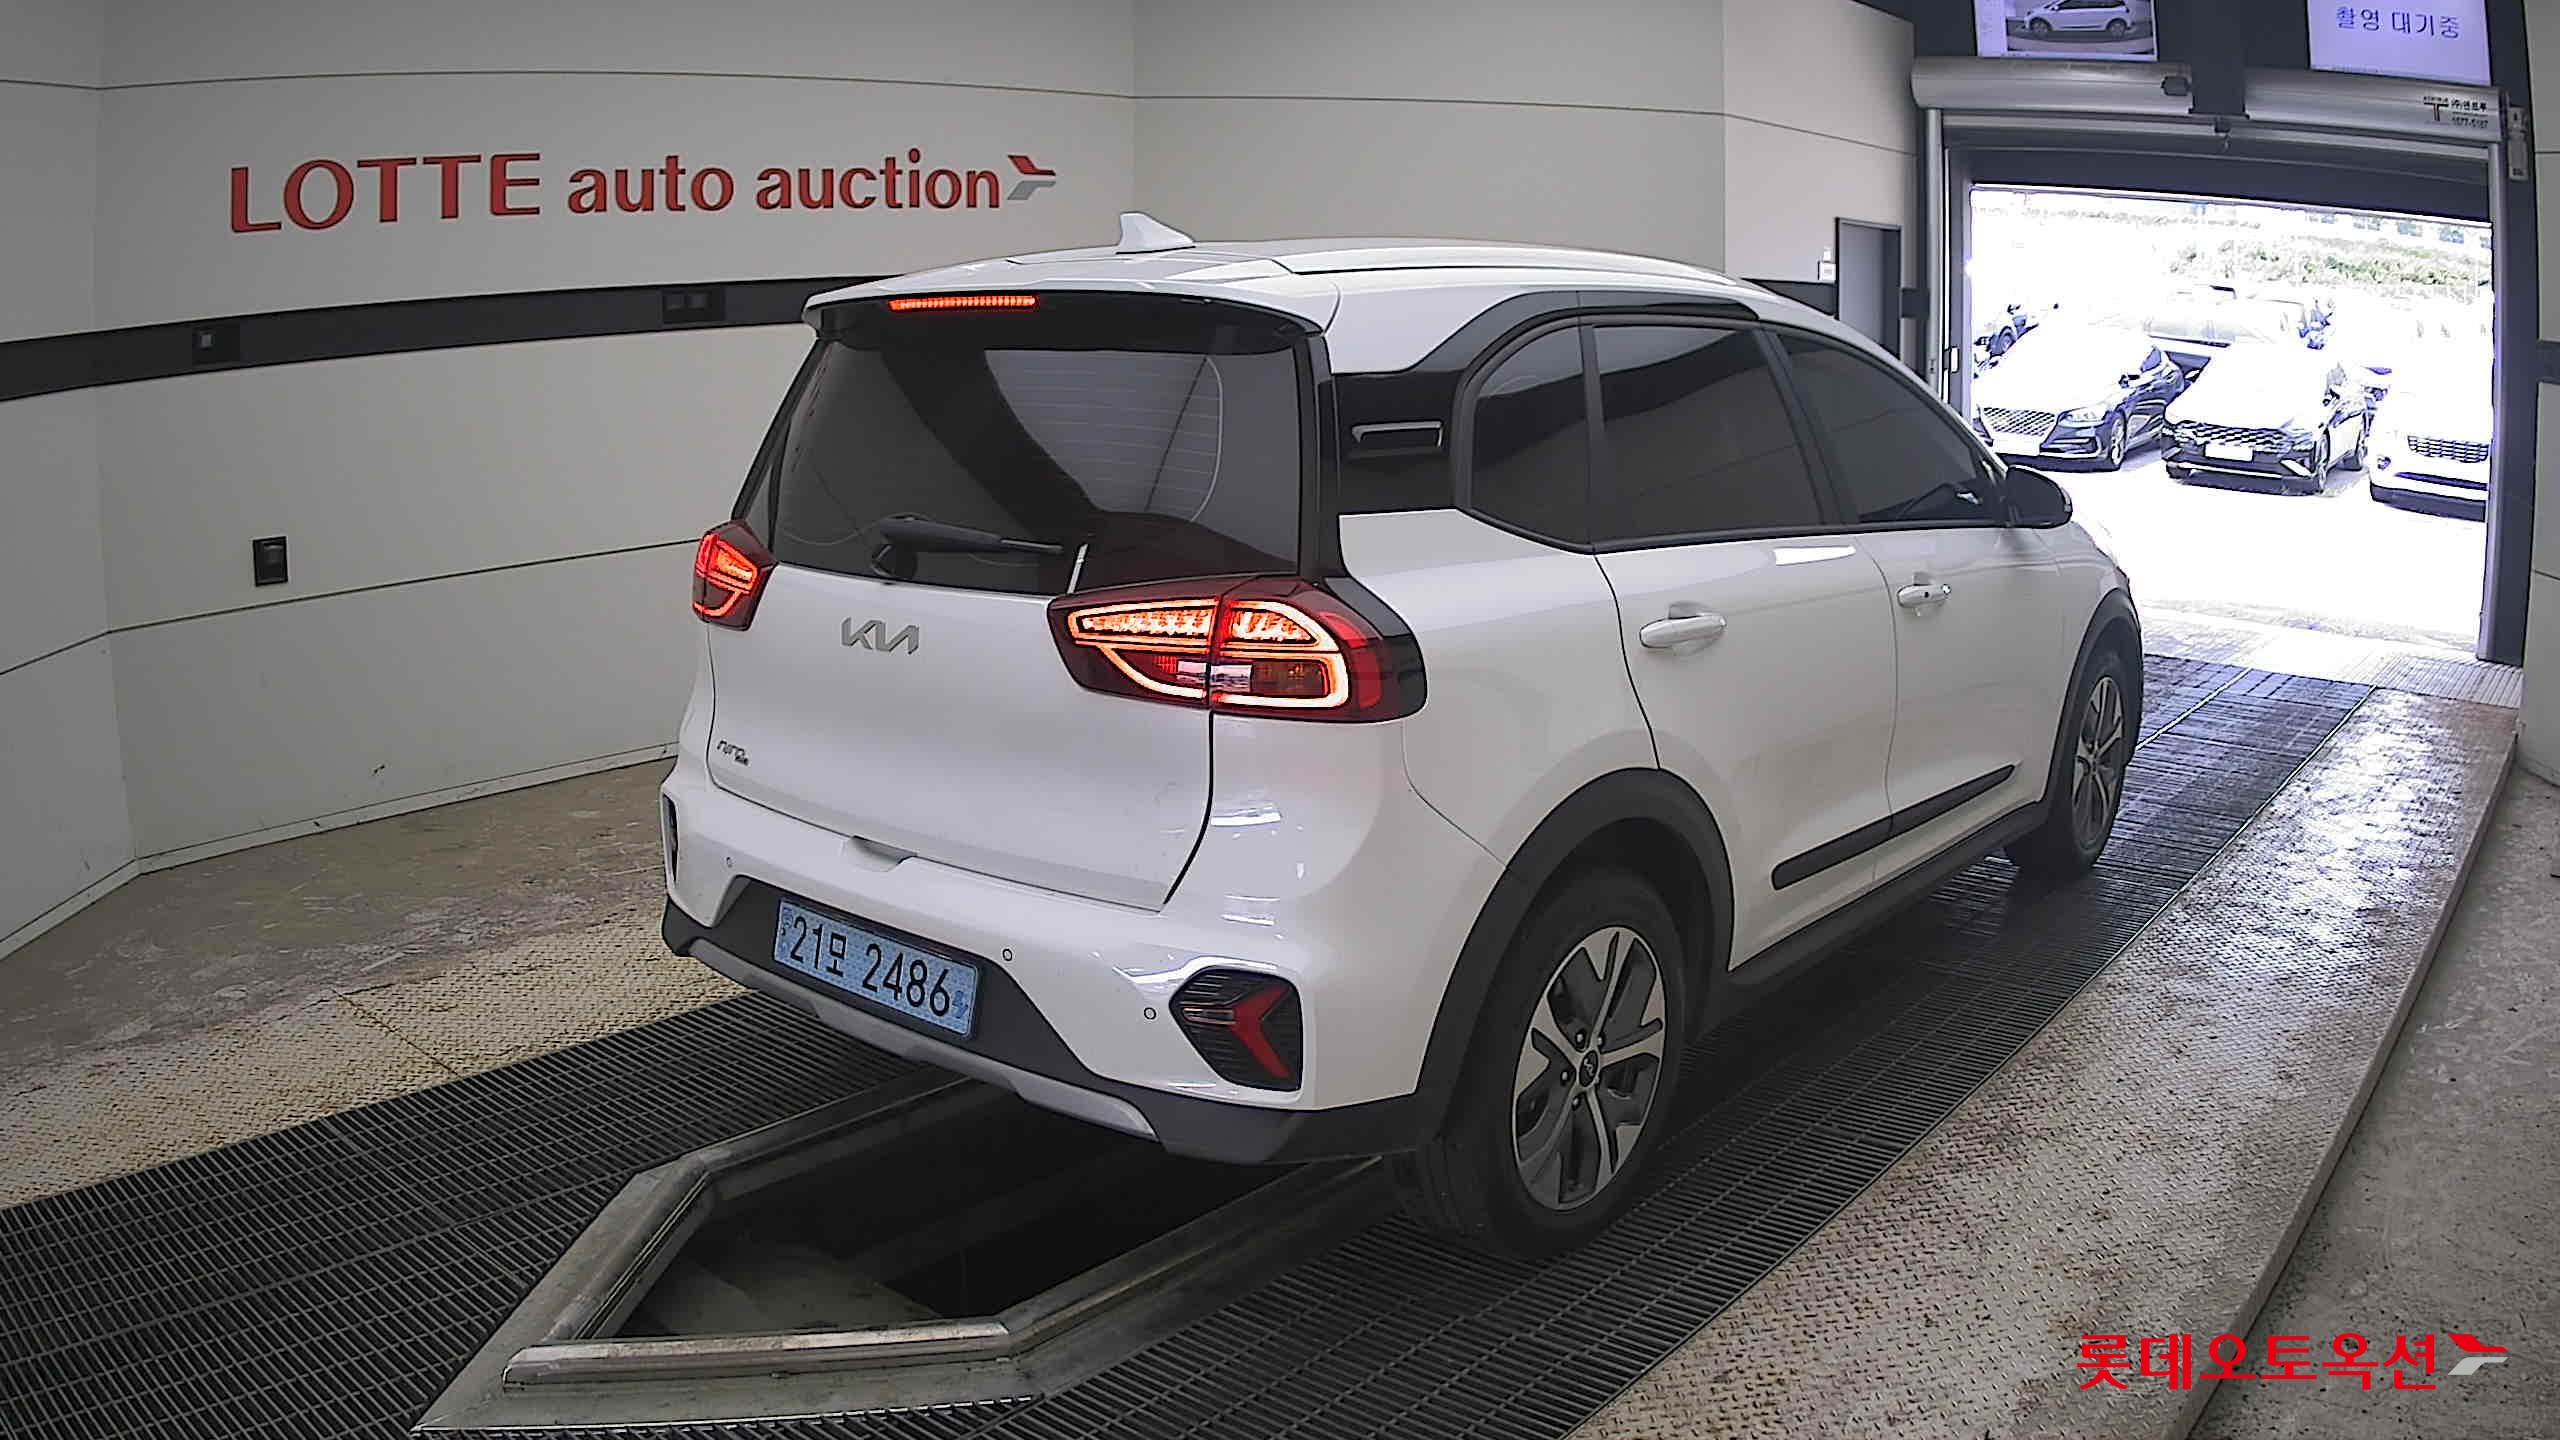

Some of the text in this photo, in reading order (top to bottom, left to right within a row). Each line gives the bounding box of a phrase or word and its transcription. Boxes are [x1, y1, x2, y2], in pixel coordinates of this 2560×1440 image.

[2337, 6, 2460, 39] 촬영 대기중
[231, 147, 1001, 233] LOTTE auto auction
[841, 617, 919, 655] KIA
[790, 916, 847, 977] 21모
[862, 943, 950, 1017] 2486
